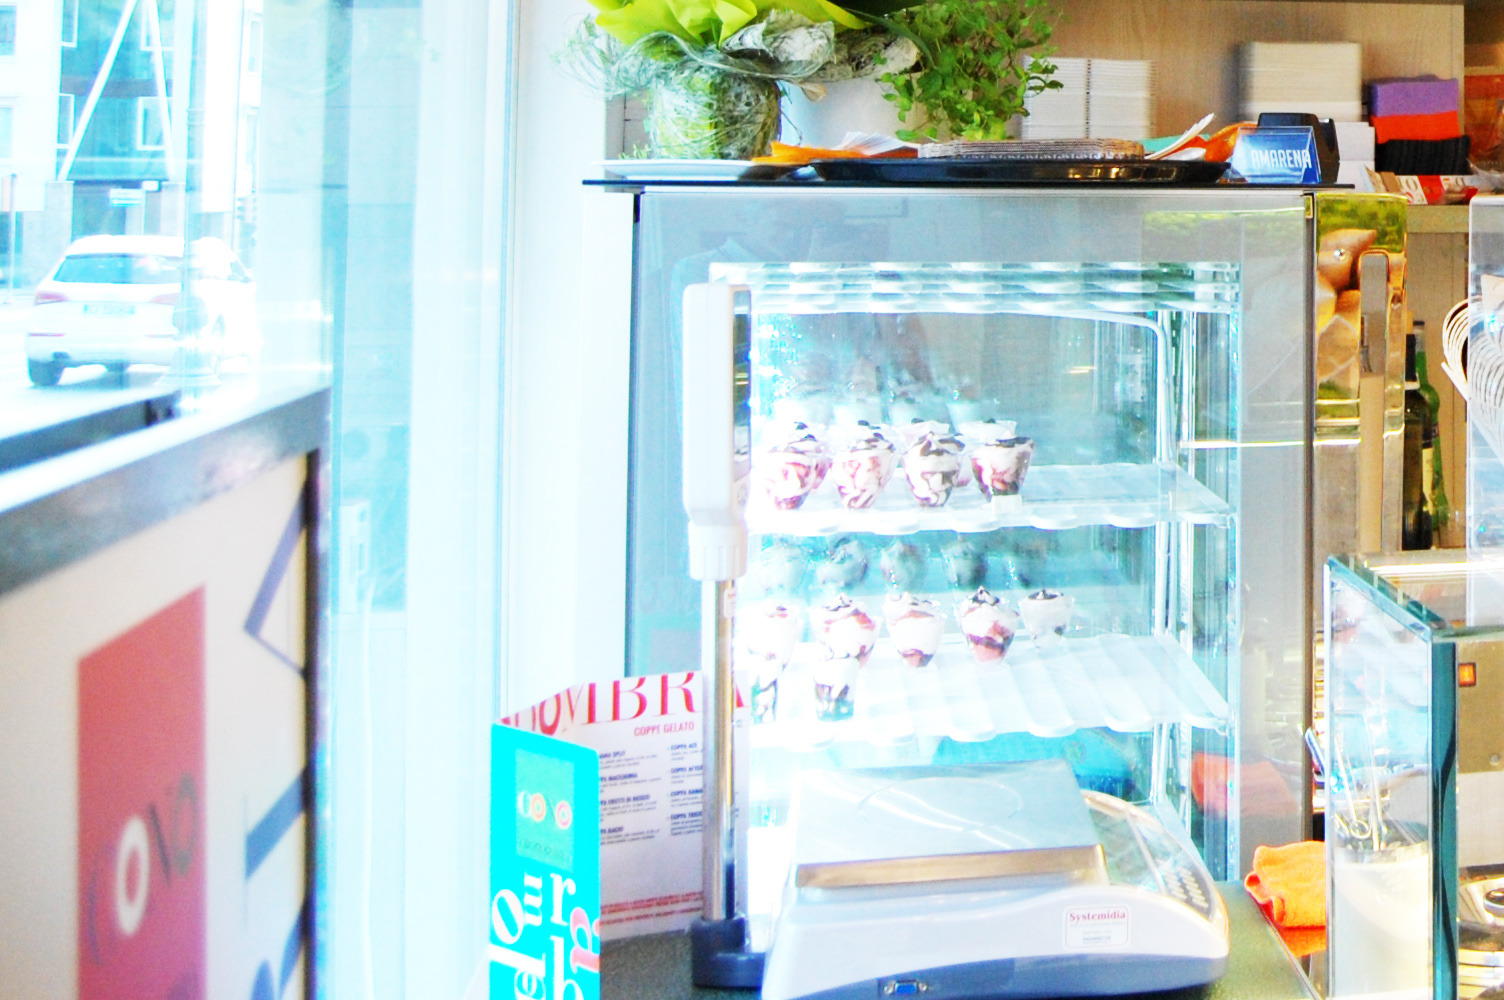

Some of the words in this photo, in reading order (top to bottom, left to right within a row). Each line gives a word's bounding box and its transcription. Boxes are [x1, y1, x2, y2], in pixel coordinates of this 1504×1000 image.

[1250, 148, 1313, 170] AMARENA
[664, 721, 695, 733] GELATO
[1069, 910, 1126, 923] Systemidia
